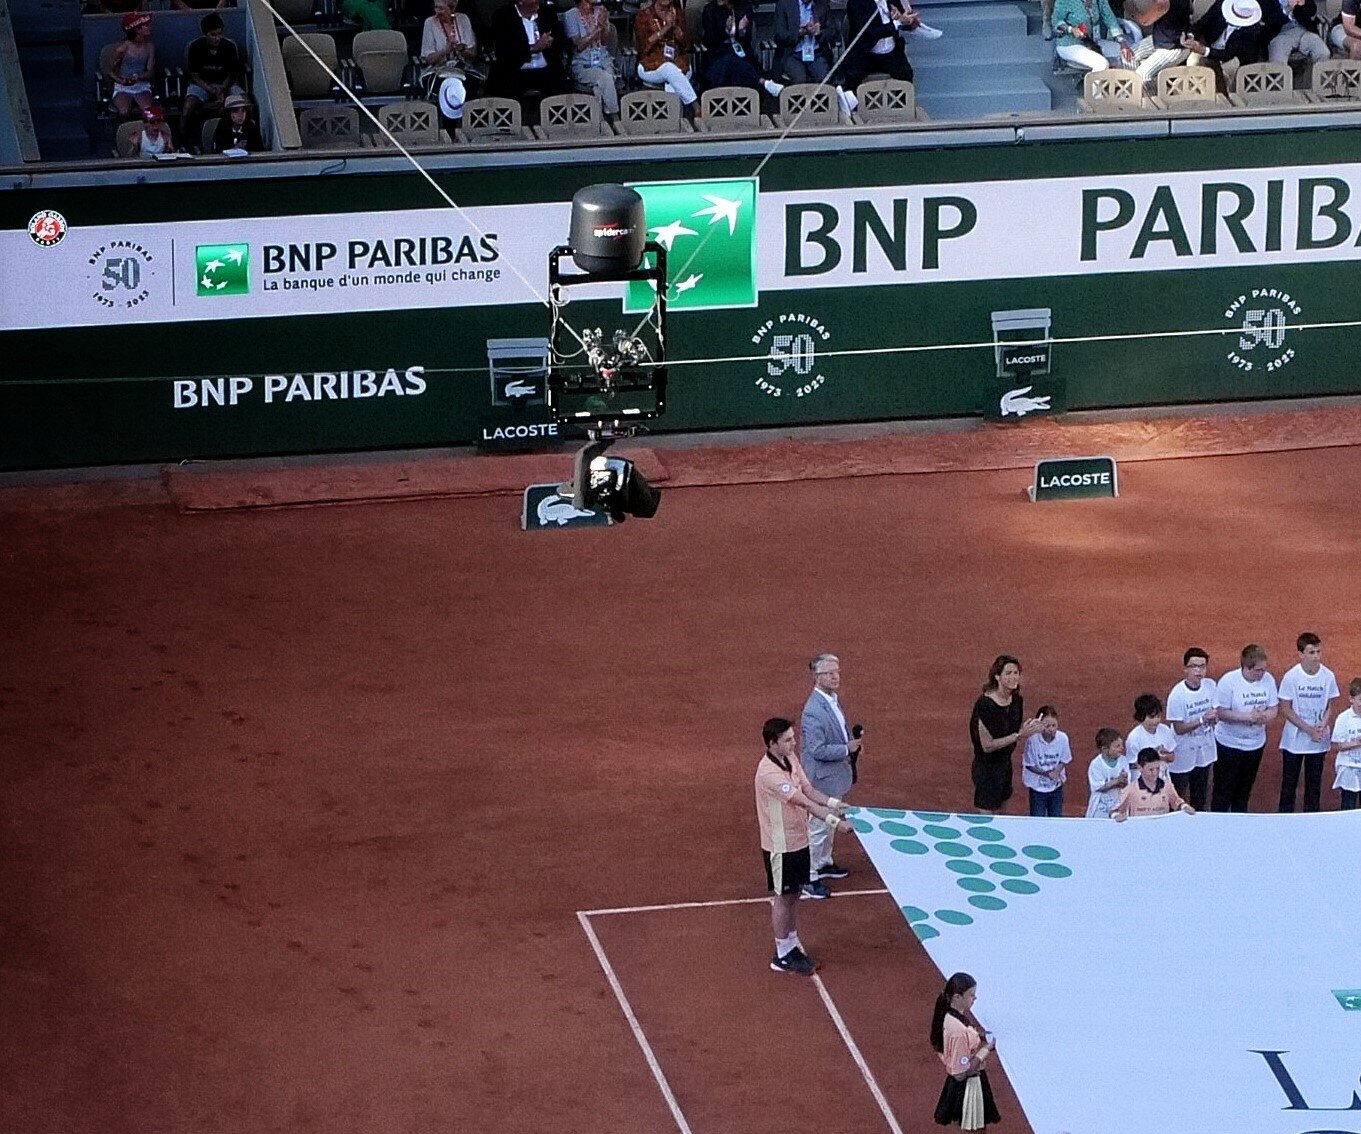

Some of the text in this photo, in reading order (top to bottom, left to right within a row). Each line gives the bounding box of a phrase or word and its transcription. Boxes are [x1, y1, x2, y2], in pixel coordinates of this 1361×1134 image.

[784, 195, 978, 277] BNP
[263, 233, 500, 274] BNP PARIBAS
[102, 257, 140, 291] 50
[263, 267, 501, 292] La banque d'un monde qui change
[1223, 288, 1302, 320] BNP PARIBAS
[752, 313, 831, 344] BNP PARIBAS
[1239, 308, 1287, 351] 50
[767, 334, 815, 376] 50
[1006, 353, 1047, 365] LACOSTE
[1227, 348, 1296, 372] 1973 2023
[173, 366, 427, 409] BNP PARIBAS
[754, 374, 826, 398] 1973 2023
[483, 423, 559, 440] LACOSTE
[1040, 471, 1111, 489] LACOSTE
